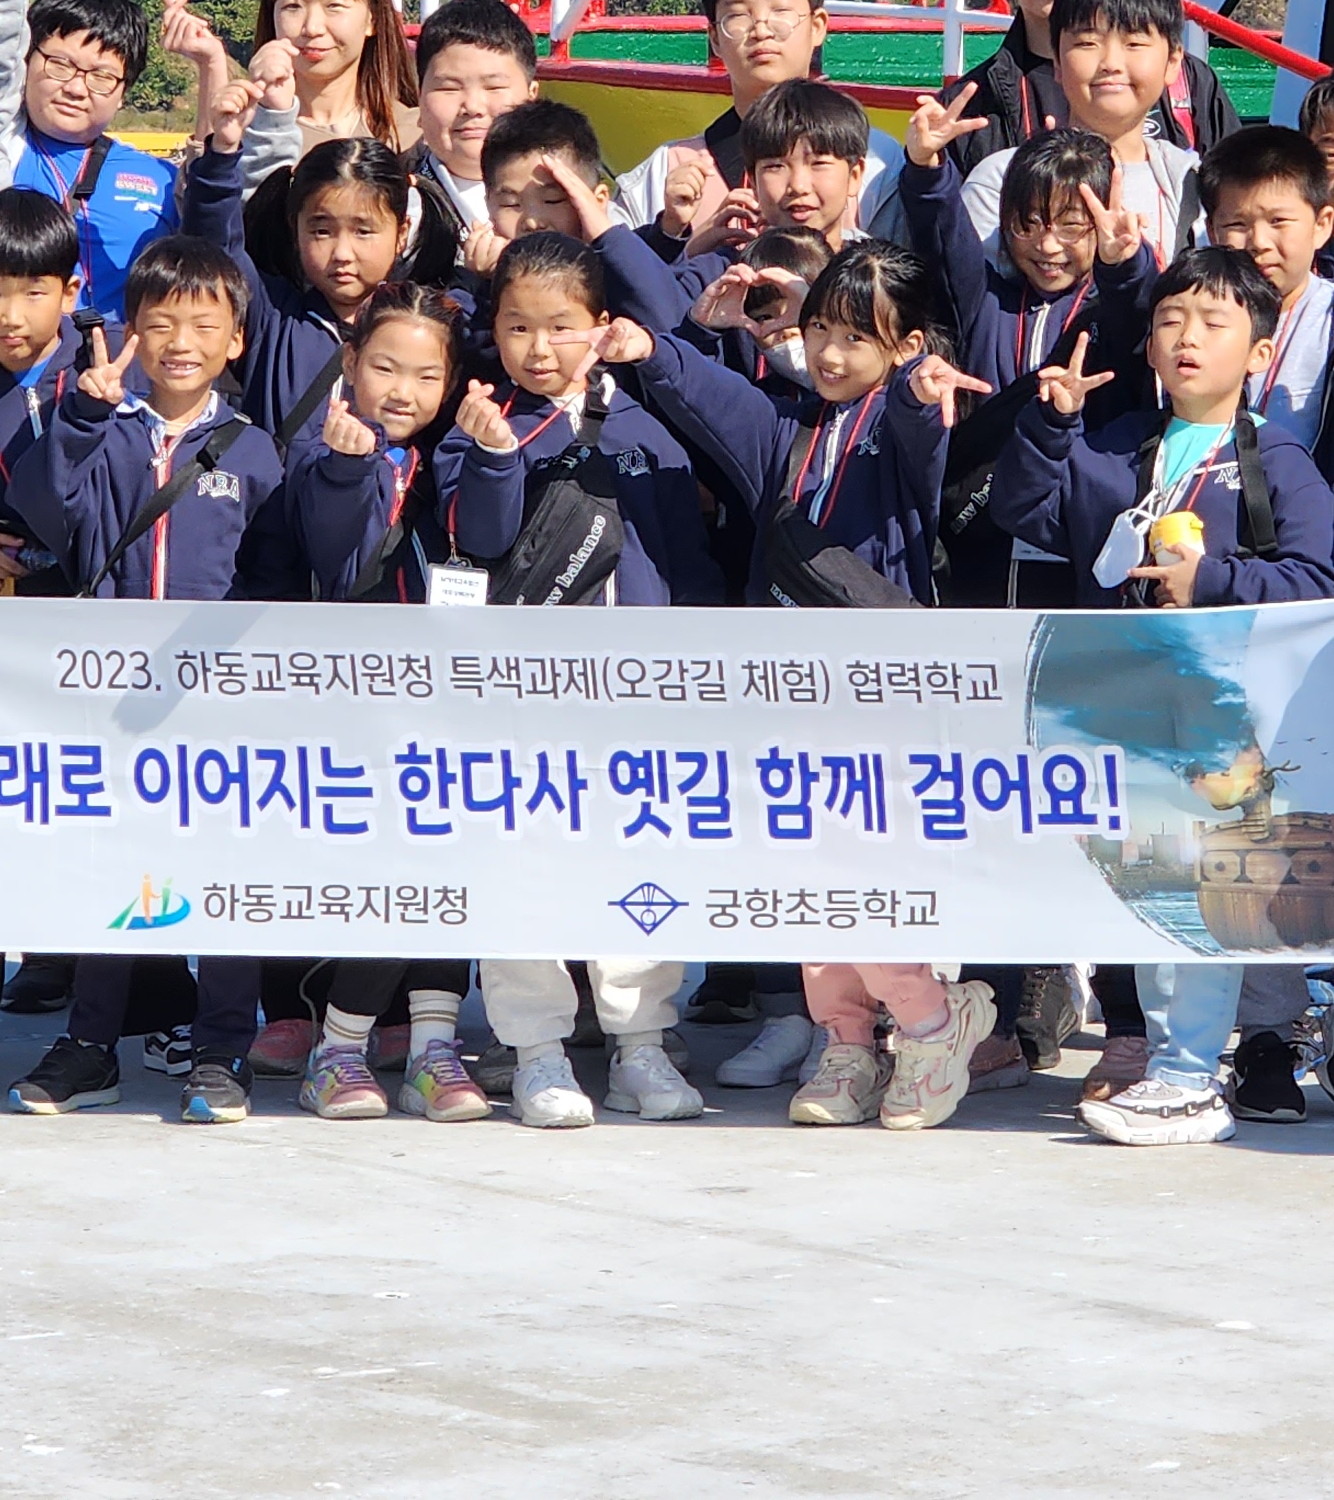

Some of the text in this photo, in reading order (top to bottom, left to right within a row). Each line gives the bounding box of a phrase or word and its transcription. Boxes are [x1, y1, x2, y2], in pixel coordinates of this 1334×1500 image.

[555, 515, 606, 589] balance
[56, 648, 1003, 705] 2023. 하동교육지원청 특색과제(오감길 체험) 협력학교
[133, 743, 374, 835] 이어지는
[394, 740, 589, 836] 한다사
[607, 748, 734, 840] 옛길
[755, 745, 887, 840] 함께
[909, 752, 1122, 841] 걸어요!
[202, 882, 469, 926] 하동교육지원청
[705, 887, 940, 930] 궁항초등학교
